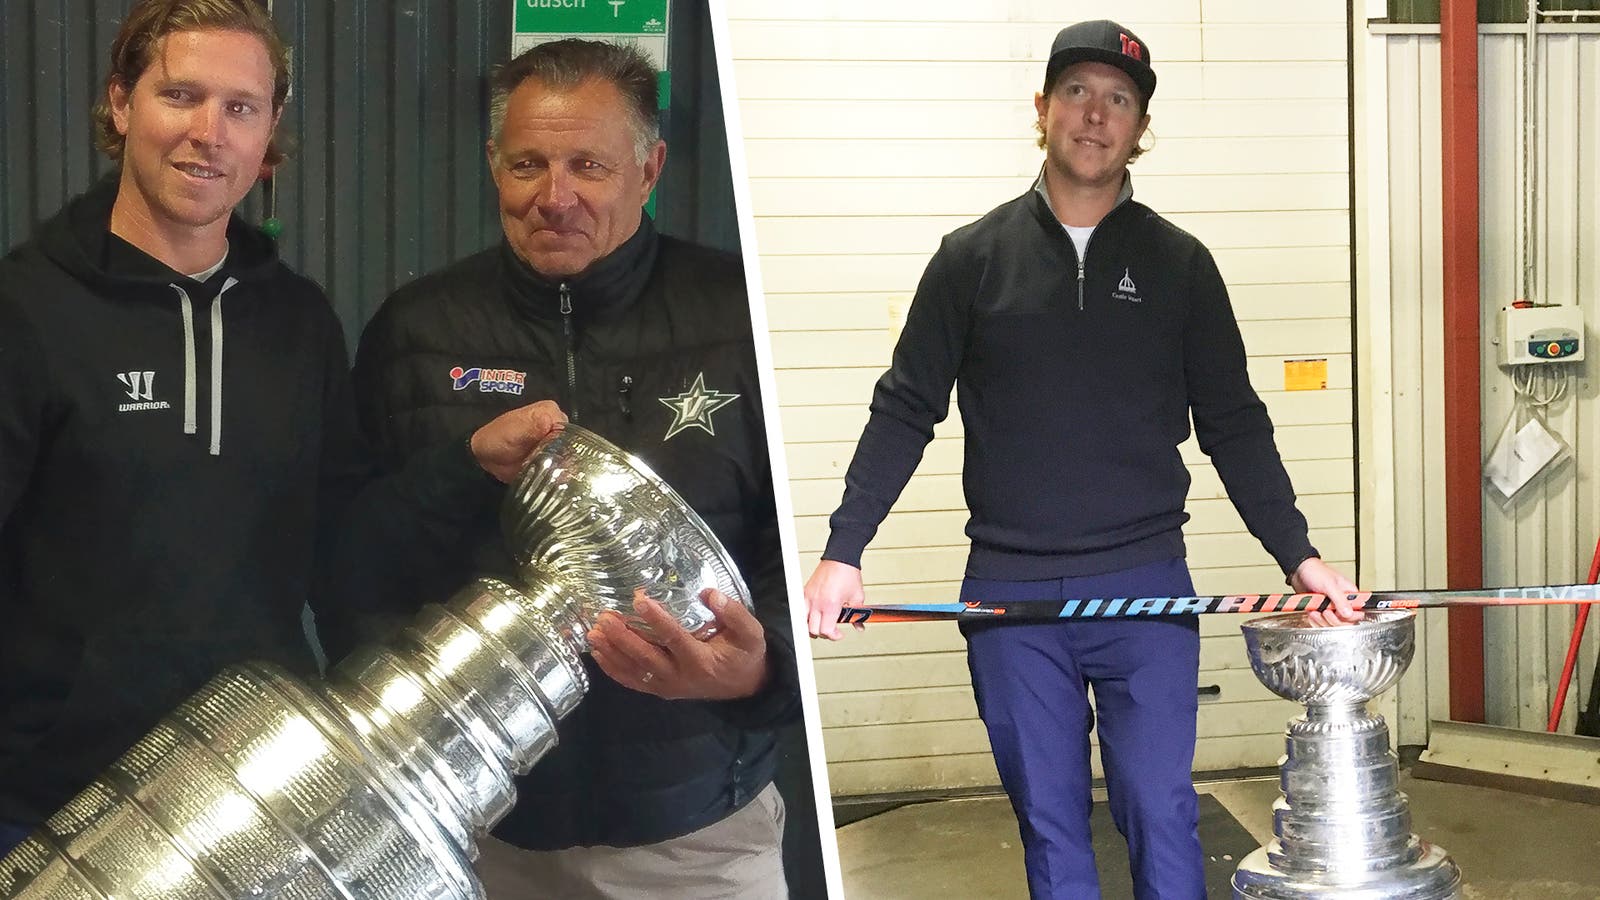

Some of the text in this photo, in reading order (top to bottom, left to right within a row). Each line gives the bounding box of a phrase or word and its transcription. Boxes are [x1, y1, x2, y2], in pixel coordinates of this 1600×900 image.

[481, 369, 526, 384] INTER
[481, 380, 523, 395] SPORT
[119, 401, 168, 412] WARRIOR
